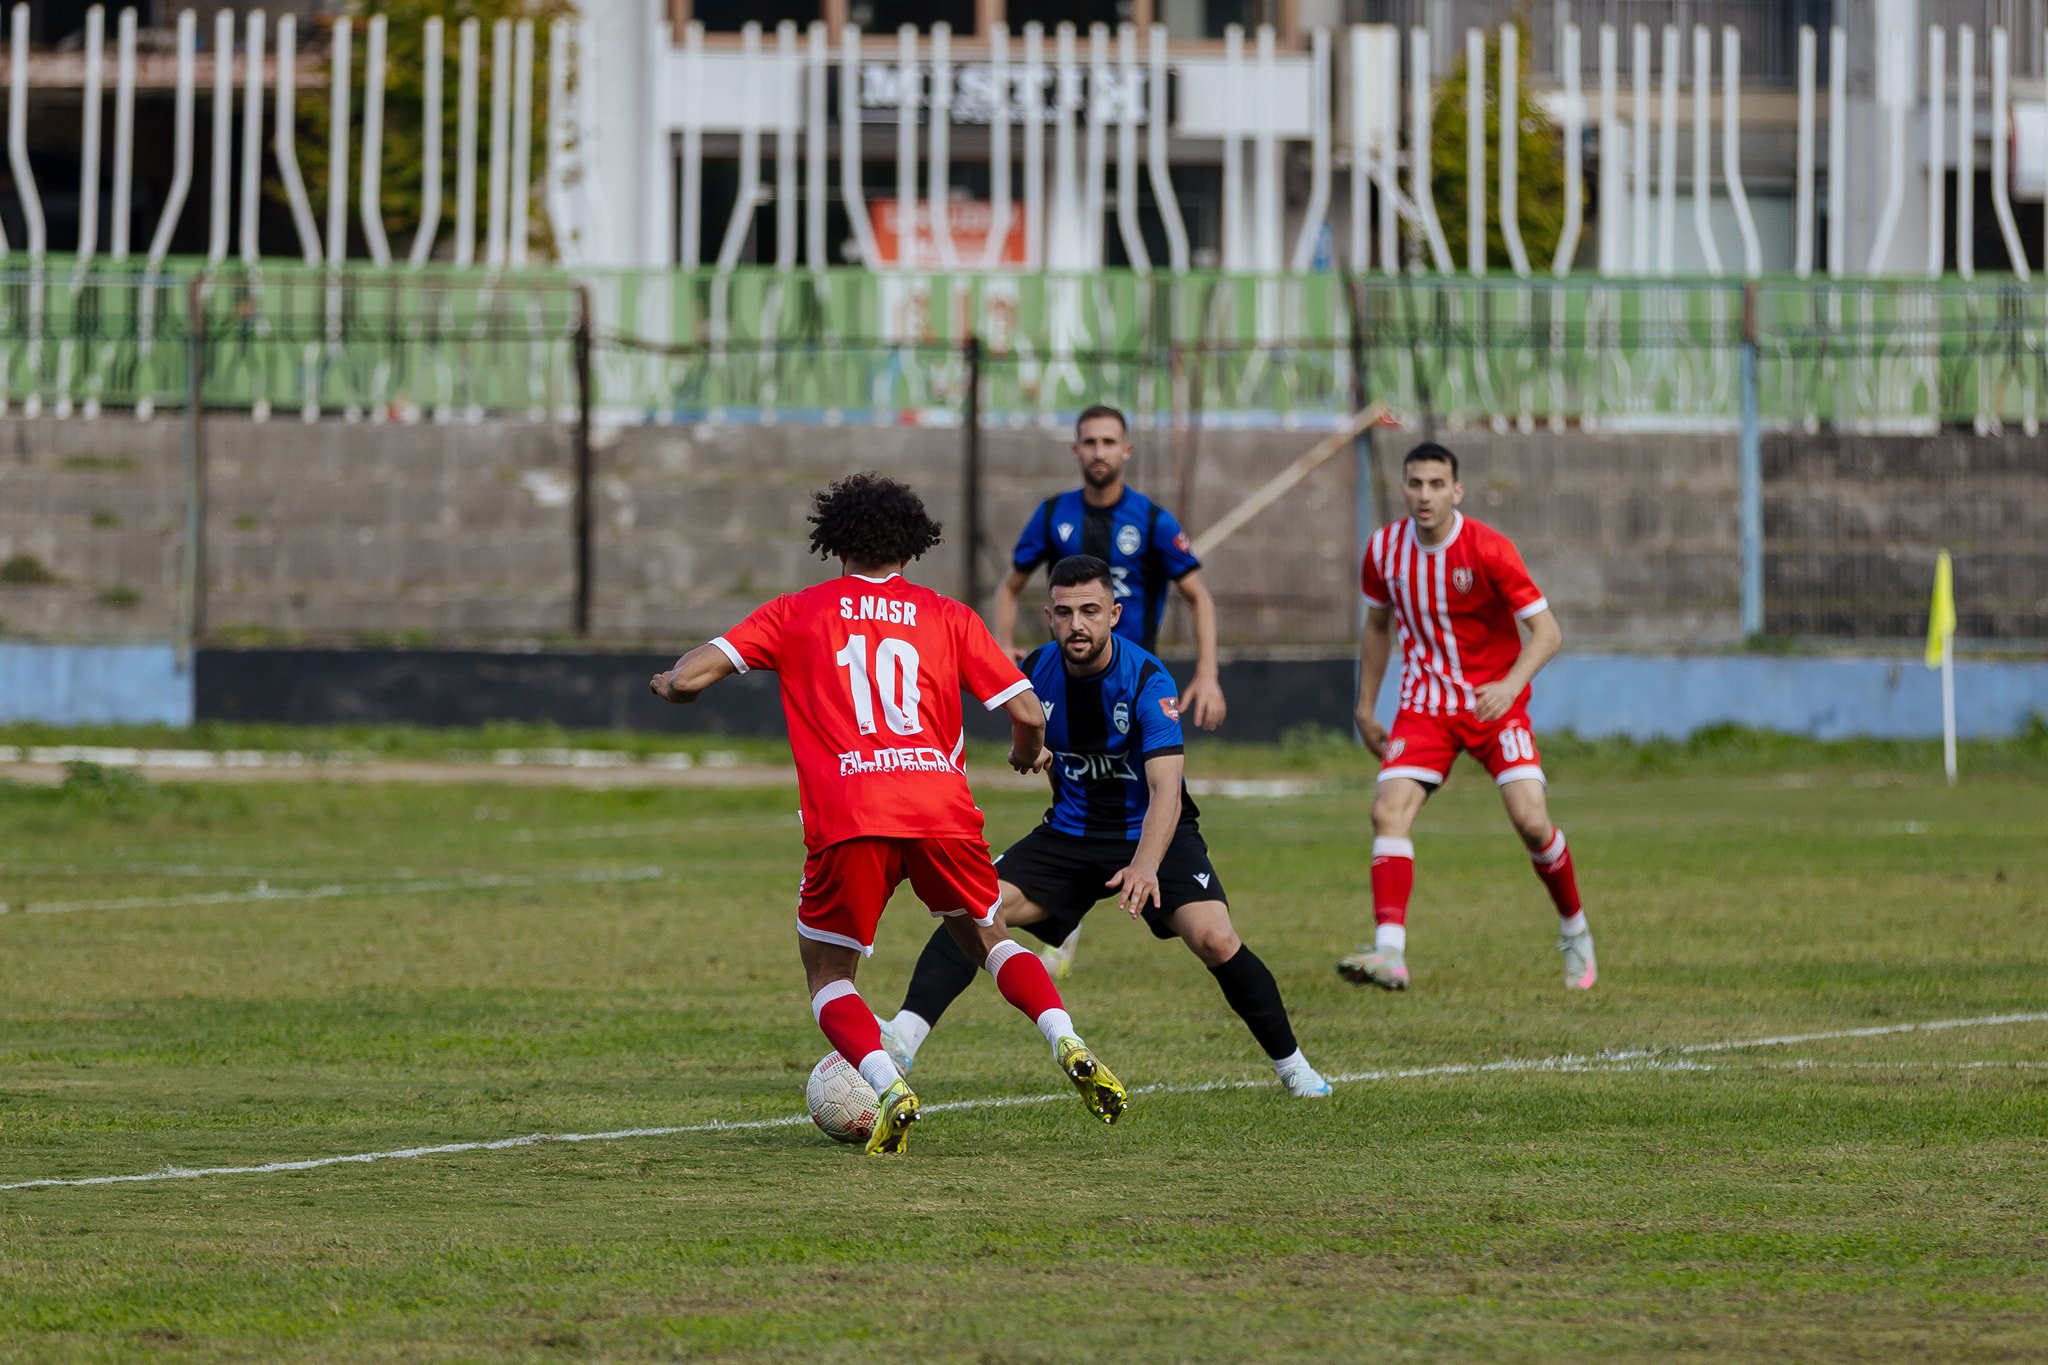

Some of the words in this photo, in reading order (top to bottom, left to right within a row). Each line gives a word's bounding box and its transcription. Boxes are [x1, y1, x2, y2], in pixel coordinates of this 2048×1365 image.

[840, 595, 917, 627] S.NASR
[836, 633, 924, 736] 10
[1498, 726, 1535, 762] 80
[902, 762, 956, 774] FURNITUR
